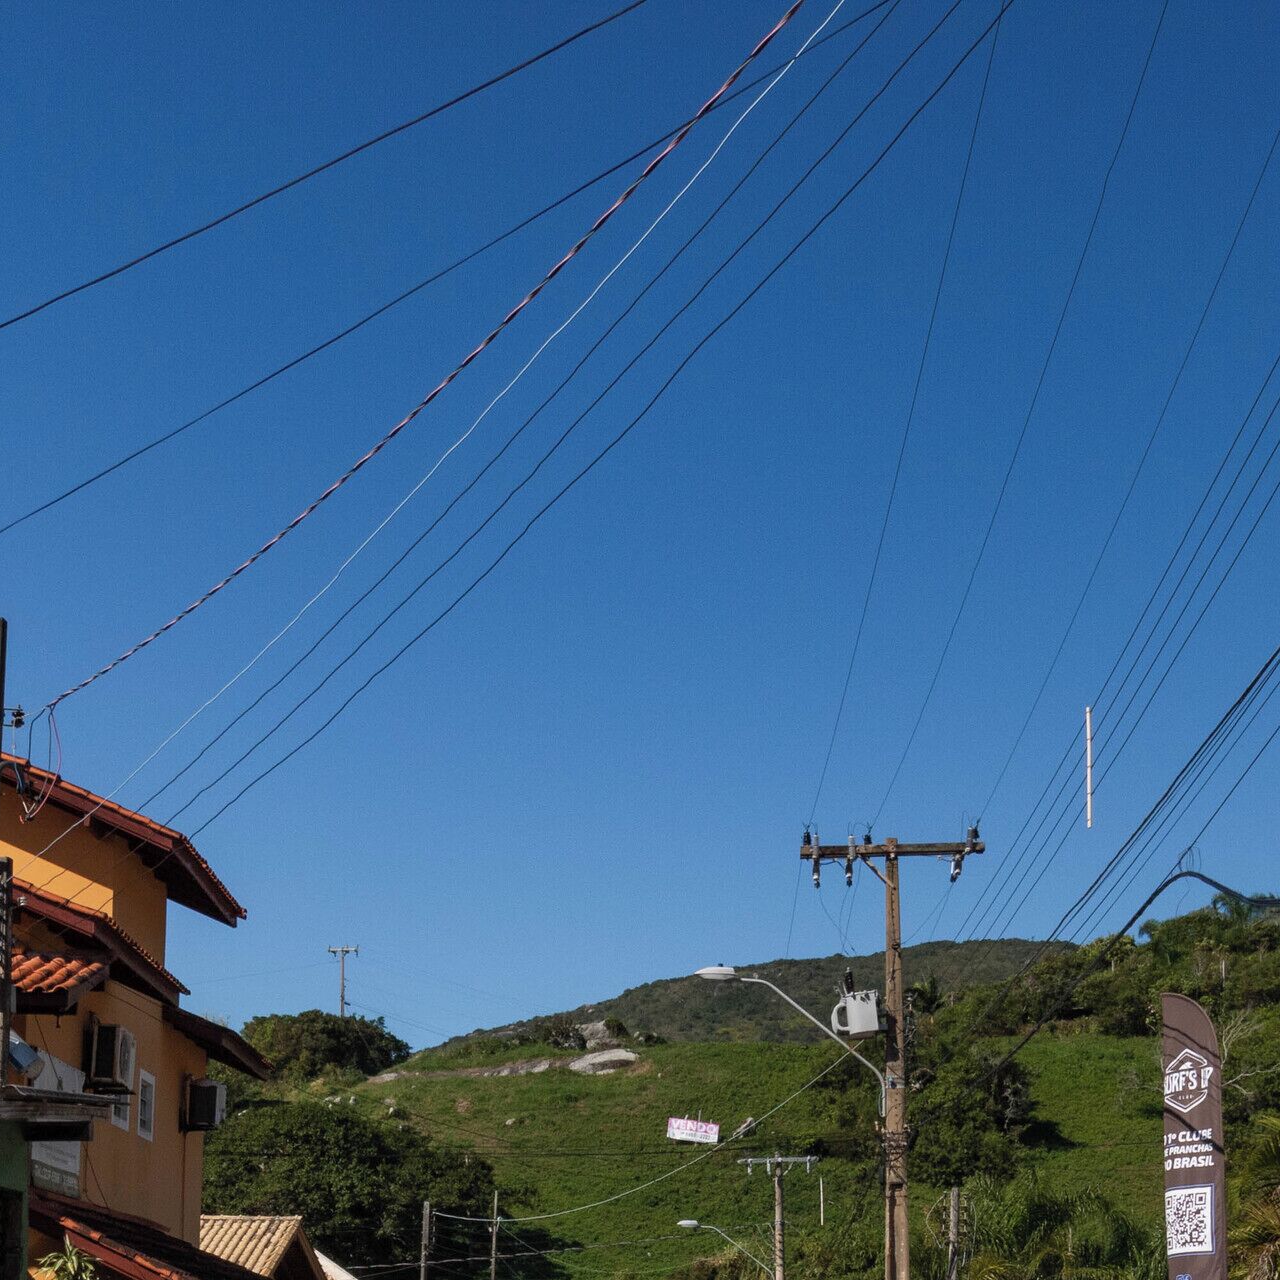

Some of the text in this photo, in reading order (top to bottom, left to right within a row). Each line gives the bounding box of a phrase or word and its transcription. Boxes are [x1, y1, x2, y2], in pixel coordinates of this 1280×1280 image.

[671, 1118, 717, 1134] VENDO
[1178, 1128, 1213, 1142] CLUBE
[1169, 1144, 1213, 1156] PRANCHAS
[1173, 1156, 1215, 1170] BRASIL
